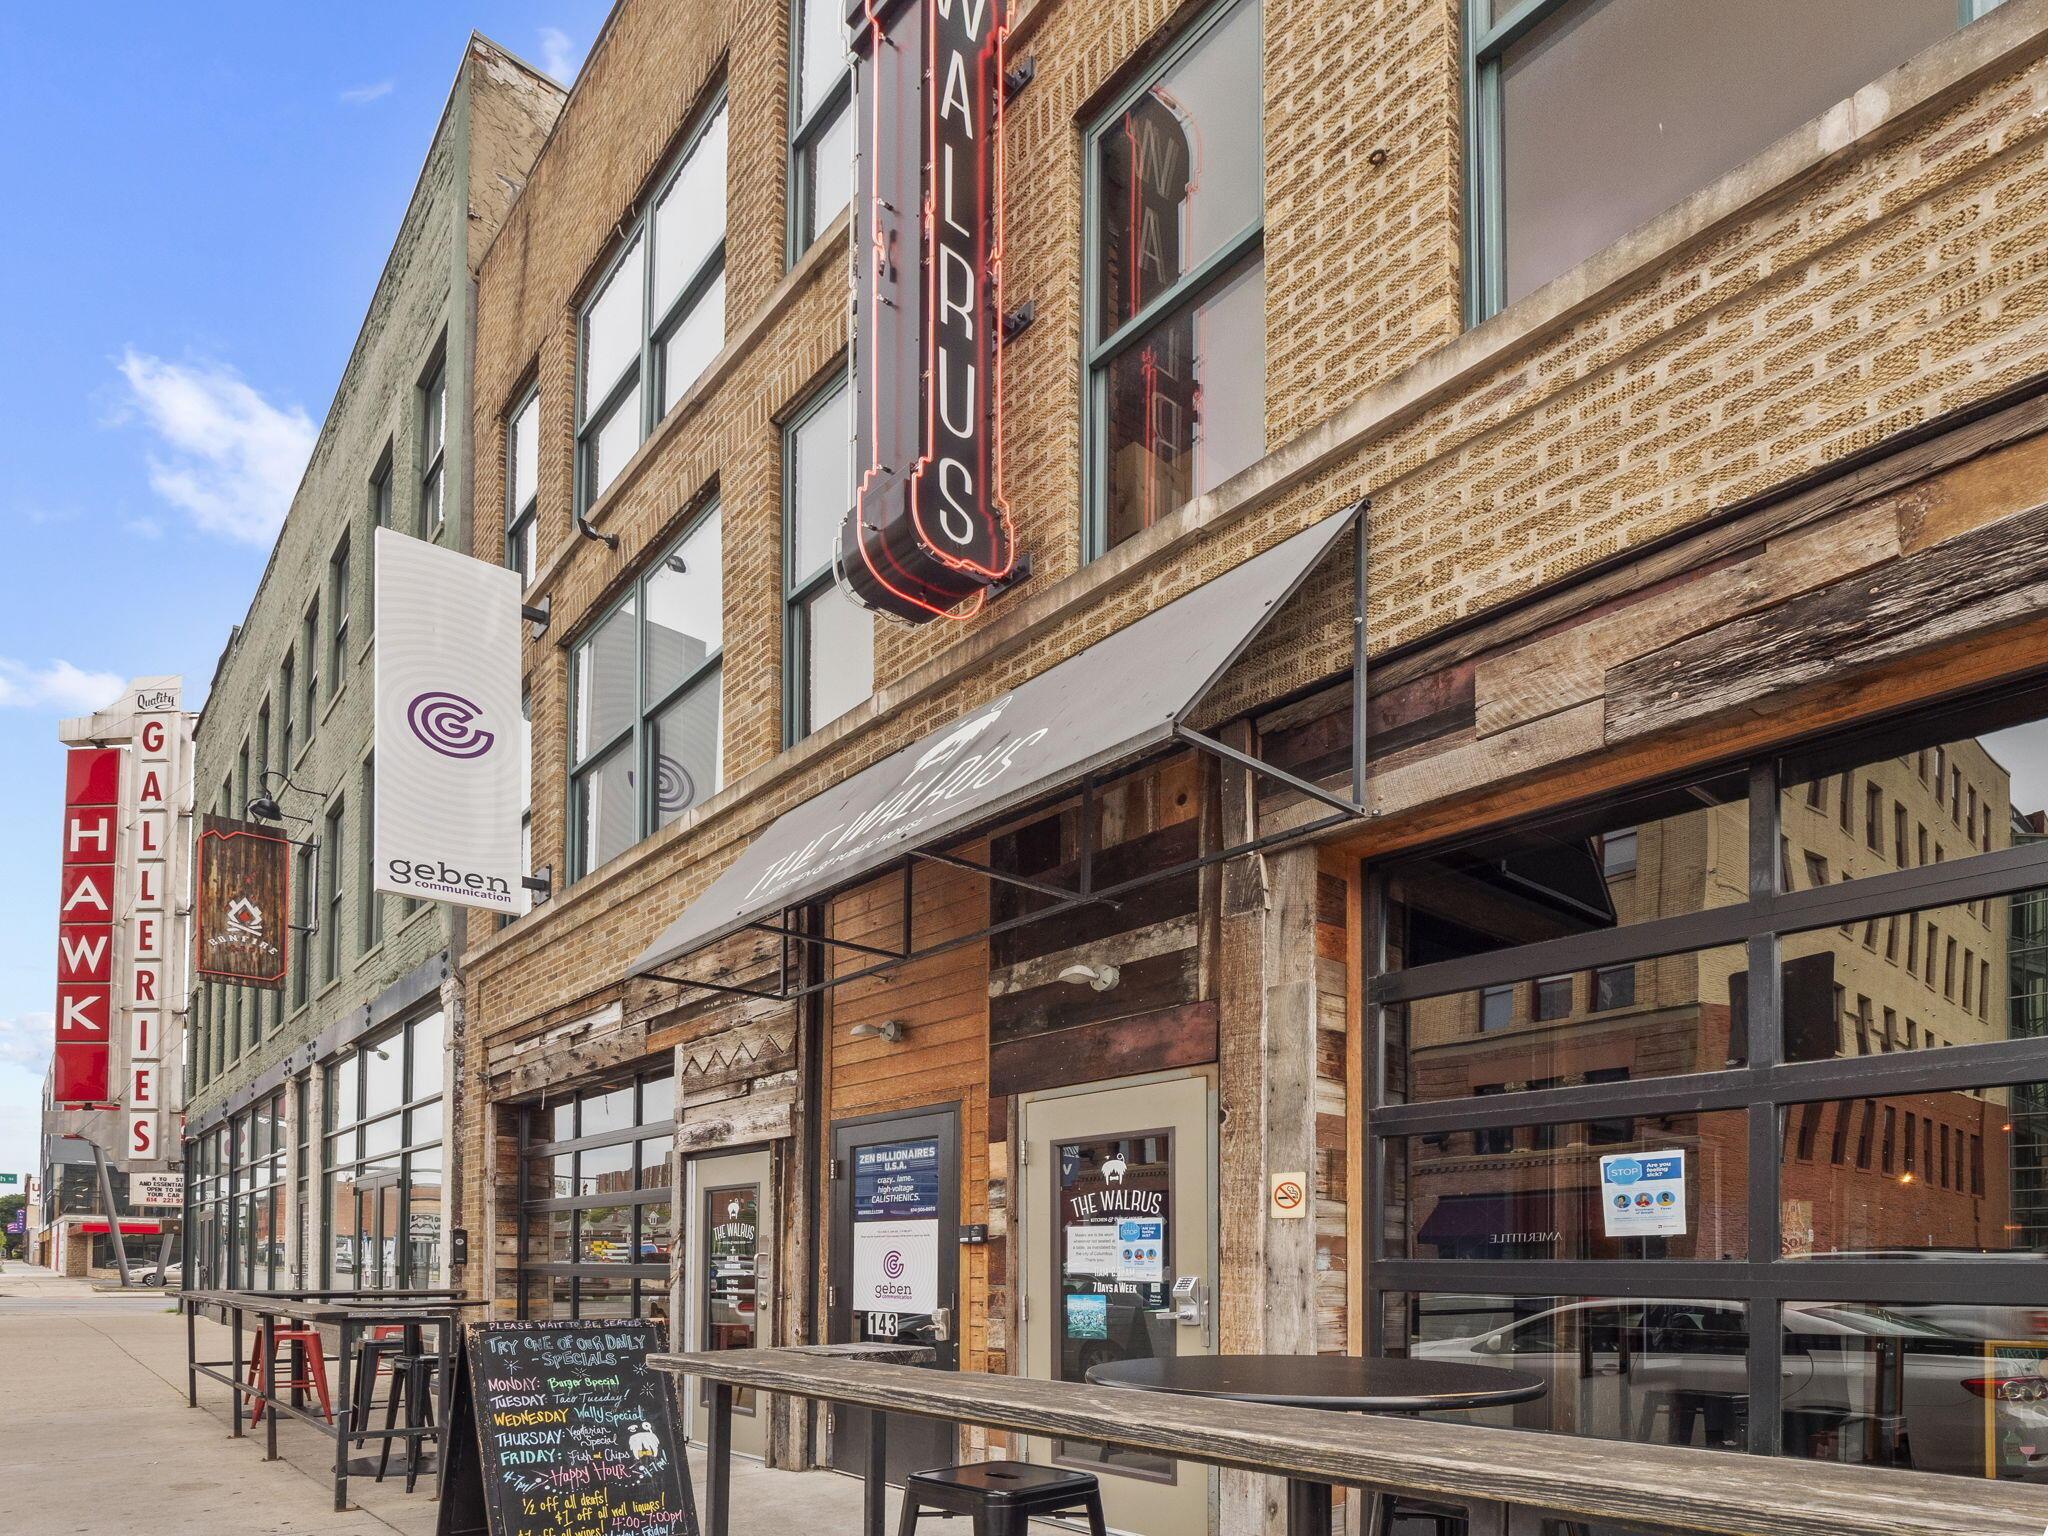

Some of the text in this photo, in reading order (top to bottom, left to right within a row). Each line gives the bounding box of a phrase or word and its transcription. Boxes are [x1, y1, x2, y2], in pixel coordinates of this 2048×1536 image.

[137, 692, 175, 710] Quality
[745, 727, 1048, 900] THE WALRUS
[389, 859, 511, 894] geben
[415, 880, 512, 903] communication
[60, 818, 109, 1030] HAWK
[134, 721, 165, 1152] GALLERIES
[208, 934, 278, 955] BONFIRE
[859, 1147, 935, 1164] ZEN BILLIONAIRES
[884, 1161, 907, 1171] U.S.A.
[1611, 1167, 1639, 1176] STOP
[1070, 1189, 1161, 1217] THE WALRUS
[713, 1222, 755, 1240] THE WALRUS
[874, 1282, 912, 1299] geben
[1092, 1282, 1096, 1293] 7
[1097, 1282, 1113, 1293] DAYS
[1119, 1282, 1138, 1294] WEEK
[489, 1321, 533, 1331] PLEASE
[538, 1320, 564, 1329] WAIT
[870, 1313, 897, 1336] 143
[485, 1333, 646, 1356] TRY ONE OF OUR DAILY
[488, 1374, 620, 1394] MONDAY: Burger Special
[490, 1389, 630, 1409] TUESDAY: Taco Tuesday!
[493, 1403, 646, 1428] WEDNESDAY Wally Special
[494, 1424, 612, 1448] THURSDAY: Vegetarian
[580, 1433, 619, 1450] Special
[500, 1448, 562, 1467] FRIDAY:
[567, 1449, 593, 1466] Fish
[604, 1448, 631, 1462] Chips
[549, 1465, 591, 1490] Happy
[540, 1495, 559, 1513] off
[564, 1493, 577, 1510] all
[555, 1509, 574, 1527] $1
[577, 1507, 593, 1521] off
[598, 1505, 609, 1519] all
[611, 1501, 628, 1518] well
